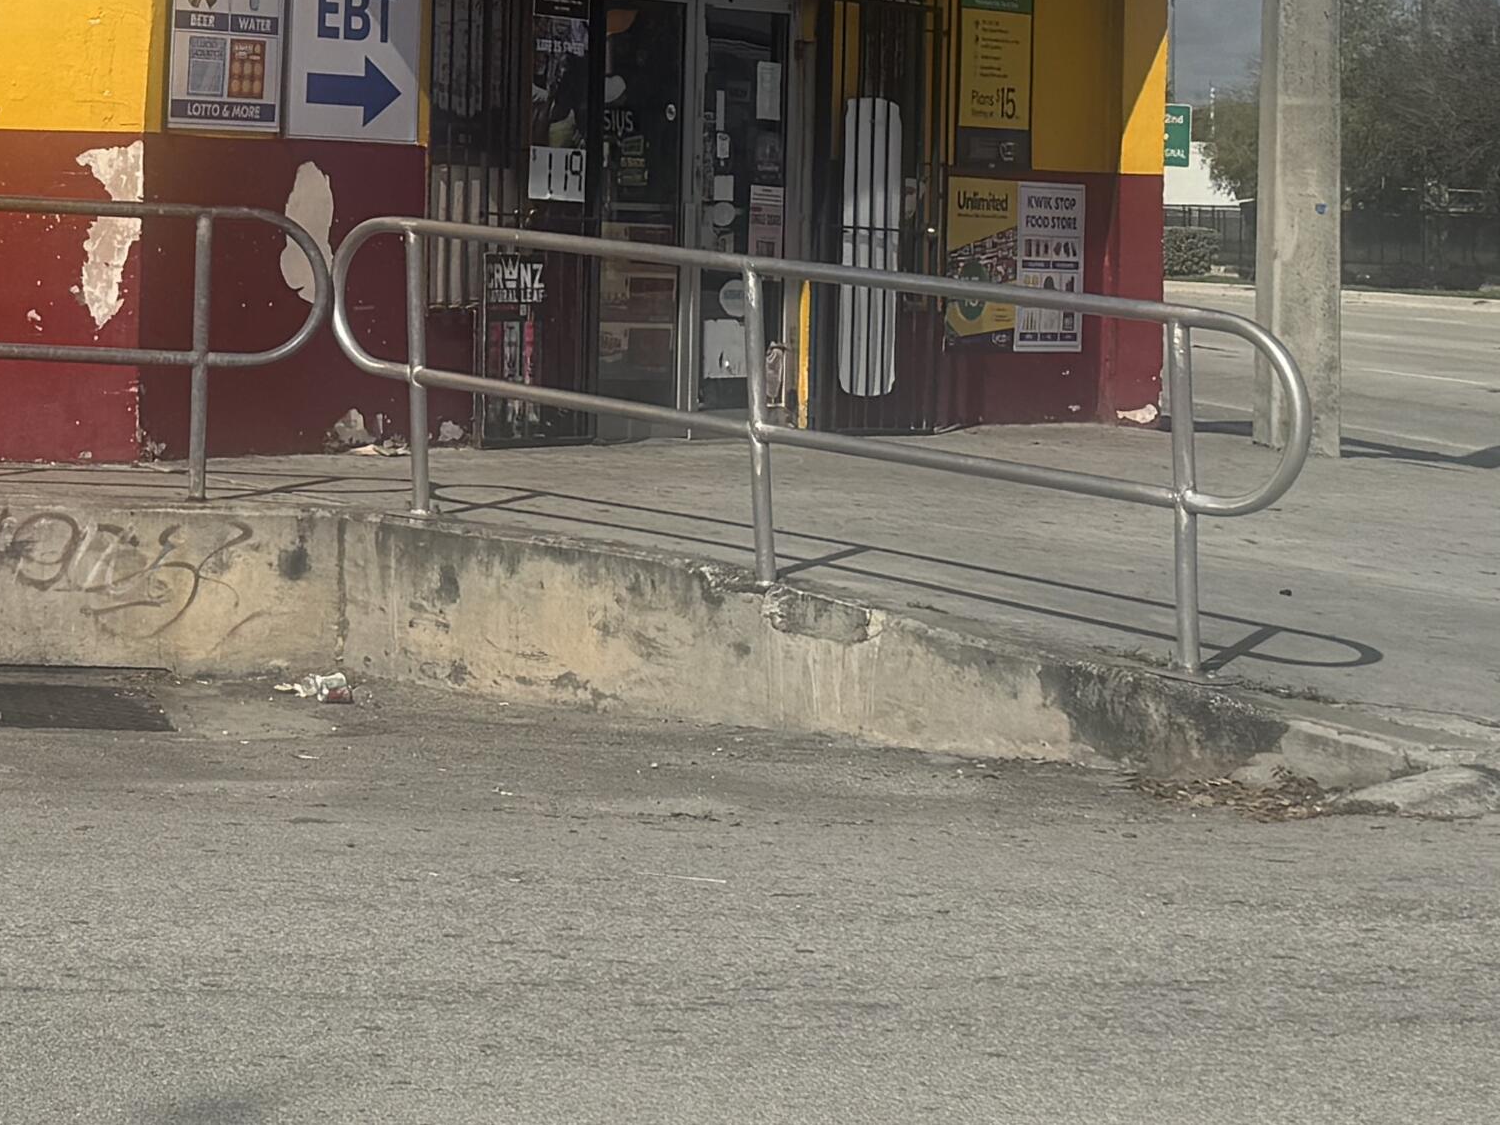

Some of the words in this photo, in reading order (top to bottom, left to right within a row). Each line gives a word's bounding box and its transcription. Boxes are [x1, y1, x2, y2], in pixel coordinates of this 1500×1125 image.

[190, 13, 215, 28] BEER
[238, 18, 272, 33] WATER
[971, 89, 994, 107] Plans
[187, 102, 220, 116] LOTTO
[222, 105, 230, 116] &
[231, 104, 261, 119] MORE
[957, 190, 1008, 212] Unlimited
[1027, 195, 1053, 210] KWIK
[1054, 196, 1077, 211] STOP
[1026, 215, 1050, 228] FOOD
[1051, 216, 1077, 230] STORE
[521, 289, 545, 303] LEAF
